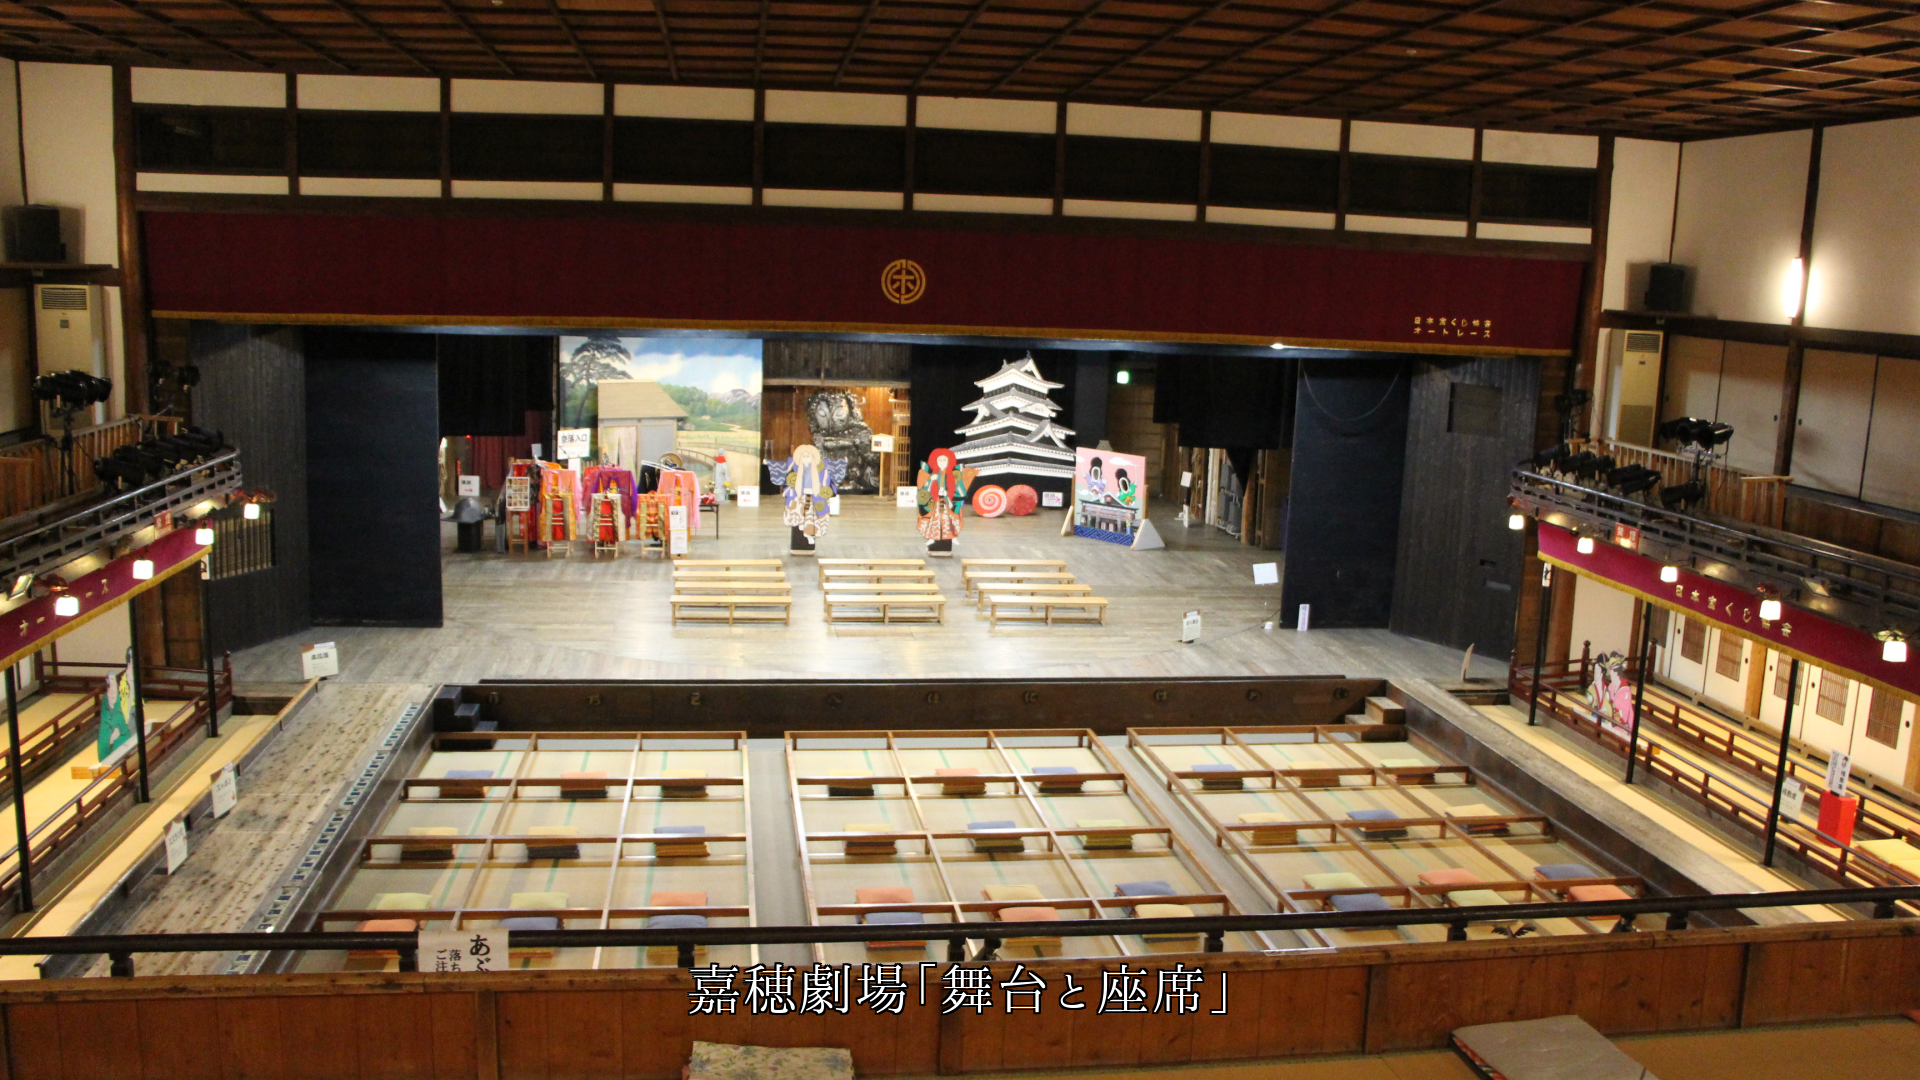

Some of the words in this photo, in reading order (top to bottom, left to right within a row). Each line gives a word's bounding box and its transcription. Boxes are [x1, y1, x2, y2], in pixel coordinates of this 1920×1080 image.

[1413, 326, 1491, 338] オートレース
